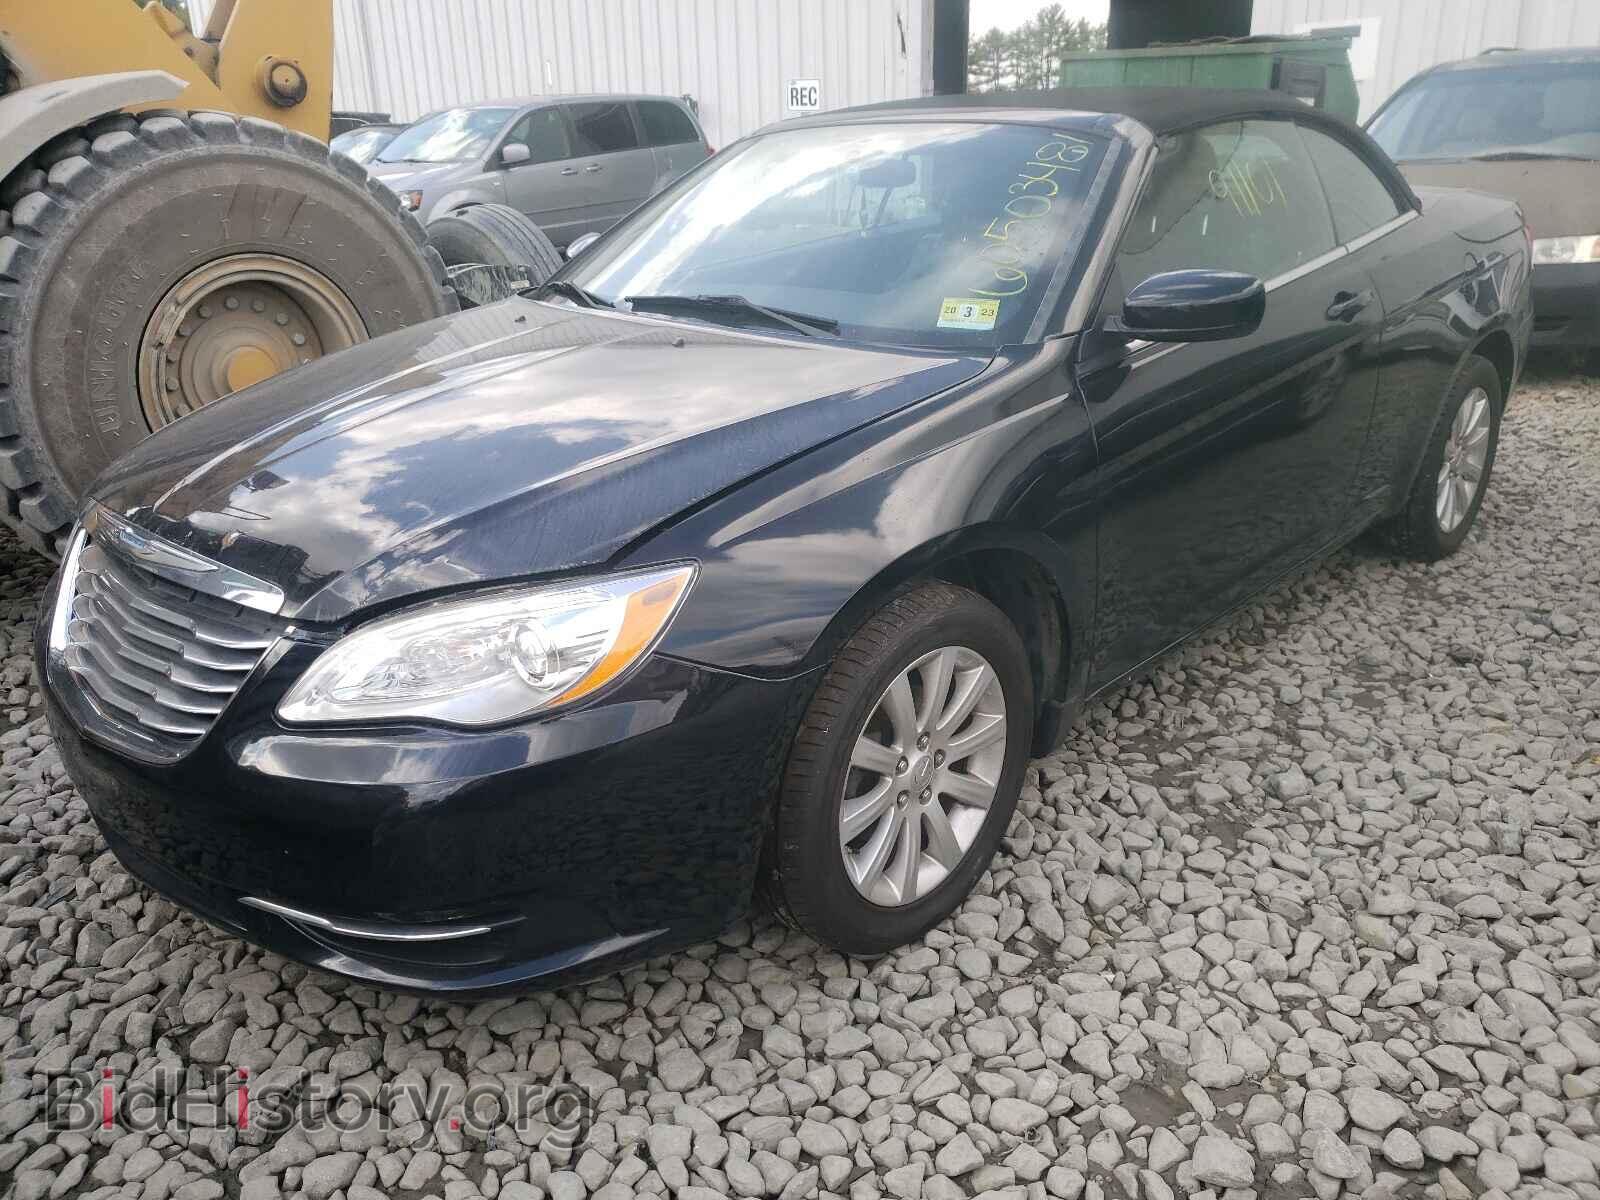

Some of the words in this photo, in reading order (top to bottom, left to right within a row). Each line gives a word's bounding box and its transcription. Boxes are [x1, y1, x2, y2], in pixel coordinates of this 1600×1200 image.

[790, 87, 817, 107] REC
[963, 305, 973, 318] 3
[981, 308, 995, 317] 23
